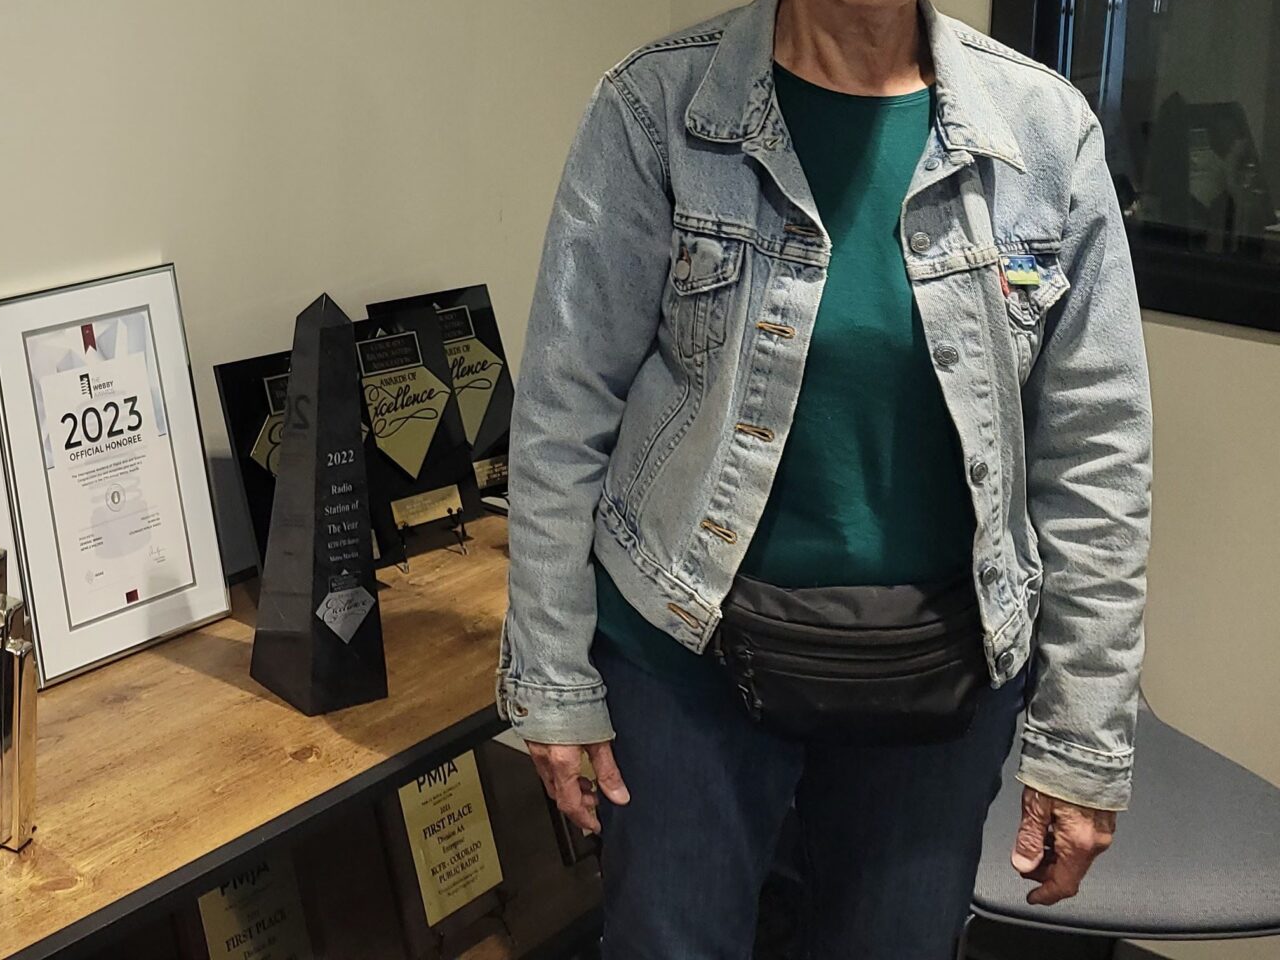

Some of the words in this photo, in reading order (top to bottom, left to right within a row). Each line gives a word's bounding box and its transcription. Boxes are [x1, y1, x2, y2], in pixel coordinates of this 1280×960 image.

[380, 373, 407, 387] AWARDS
[407, 372, 417, 381] OF
[60, 395, 143, 451] 2023
[69, 445, 104, 461] OFFICIAL
[105, 434, 142, 451] HONOREE
[327, 449, 355, 467] 2022
[331, 483, 353, 495] Radio
[324, 503, 350, 516] Station
[351, 500, 359, 511] of
[327, 523, 342, 535] The
[343, 520, 358, 532] Year
[416, 759, 458, 793] PMJA
[422, 817, 448, 840] FIRST
[447, 803, 473, 827] PLACE
[449, 840, 481, 864] COLORADO
[439, 865, 460, 884] PUBLIC
[460, 854, 479, 871] RADIO
[225, 926, 253, 952] FIRST
[255, 908, 287, 935] PLACE
